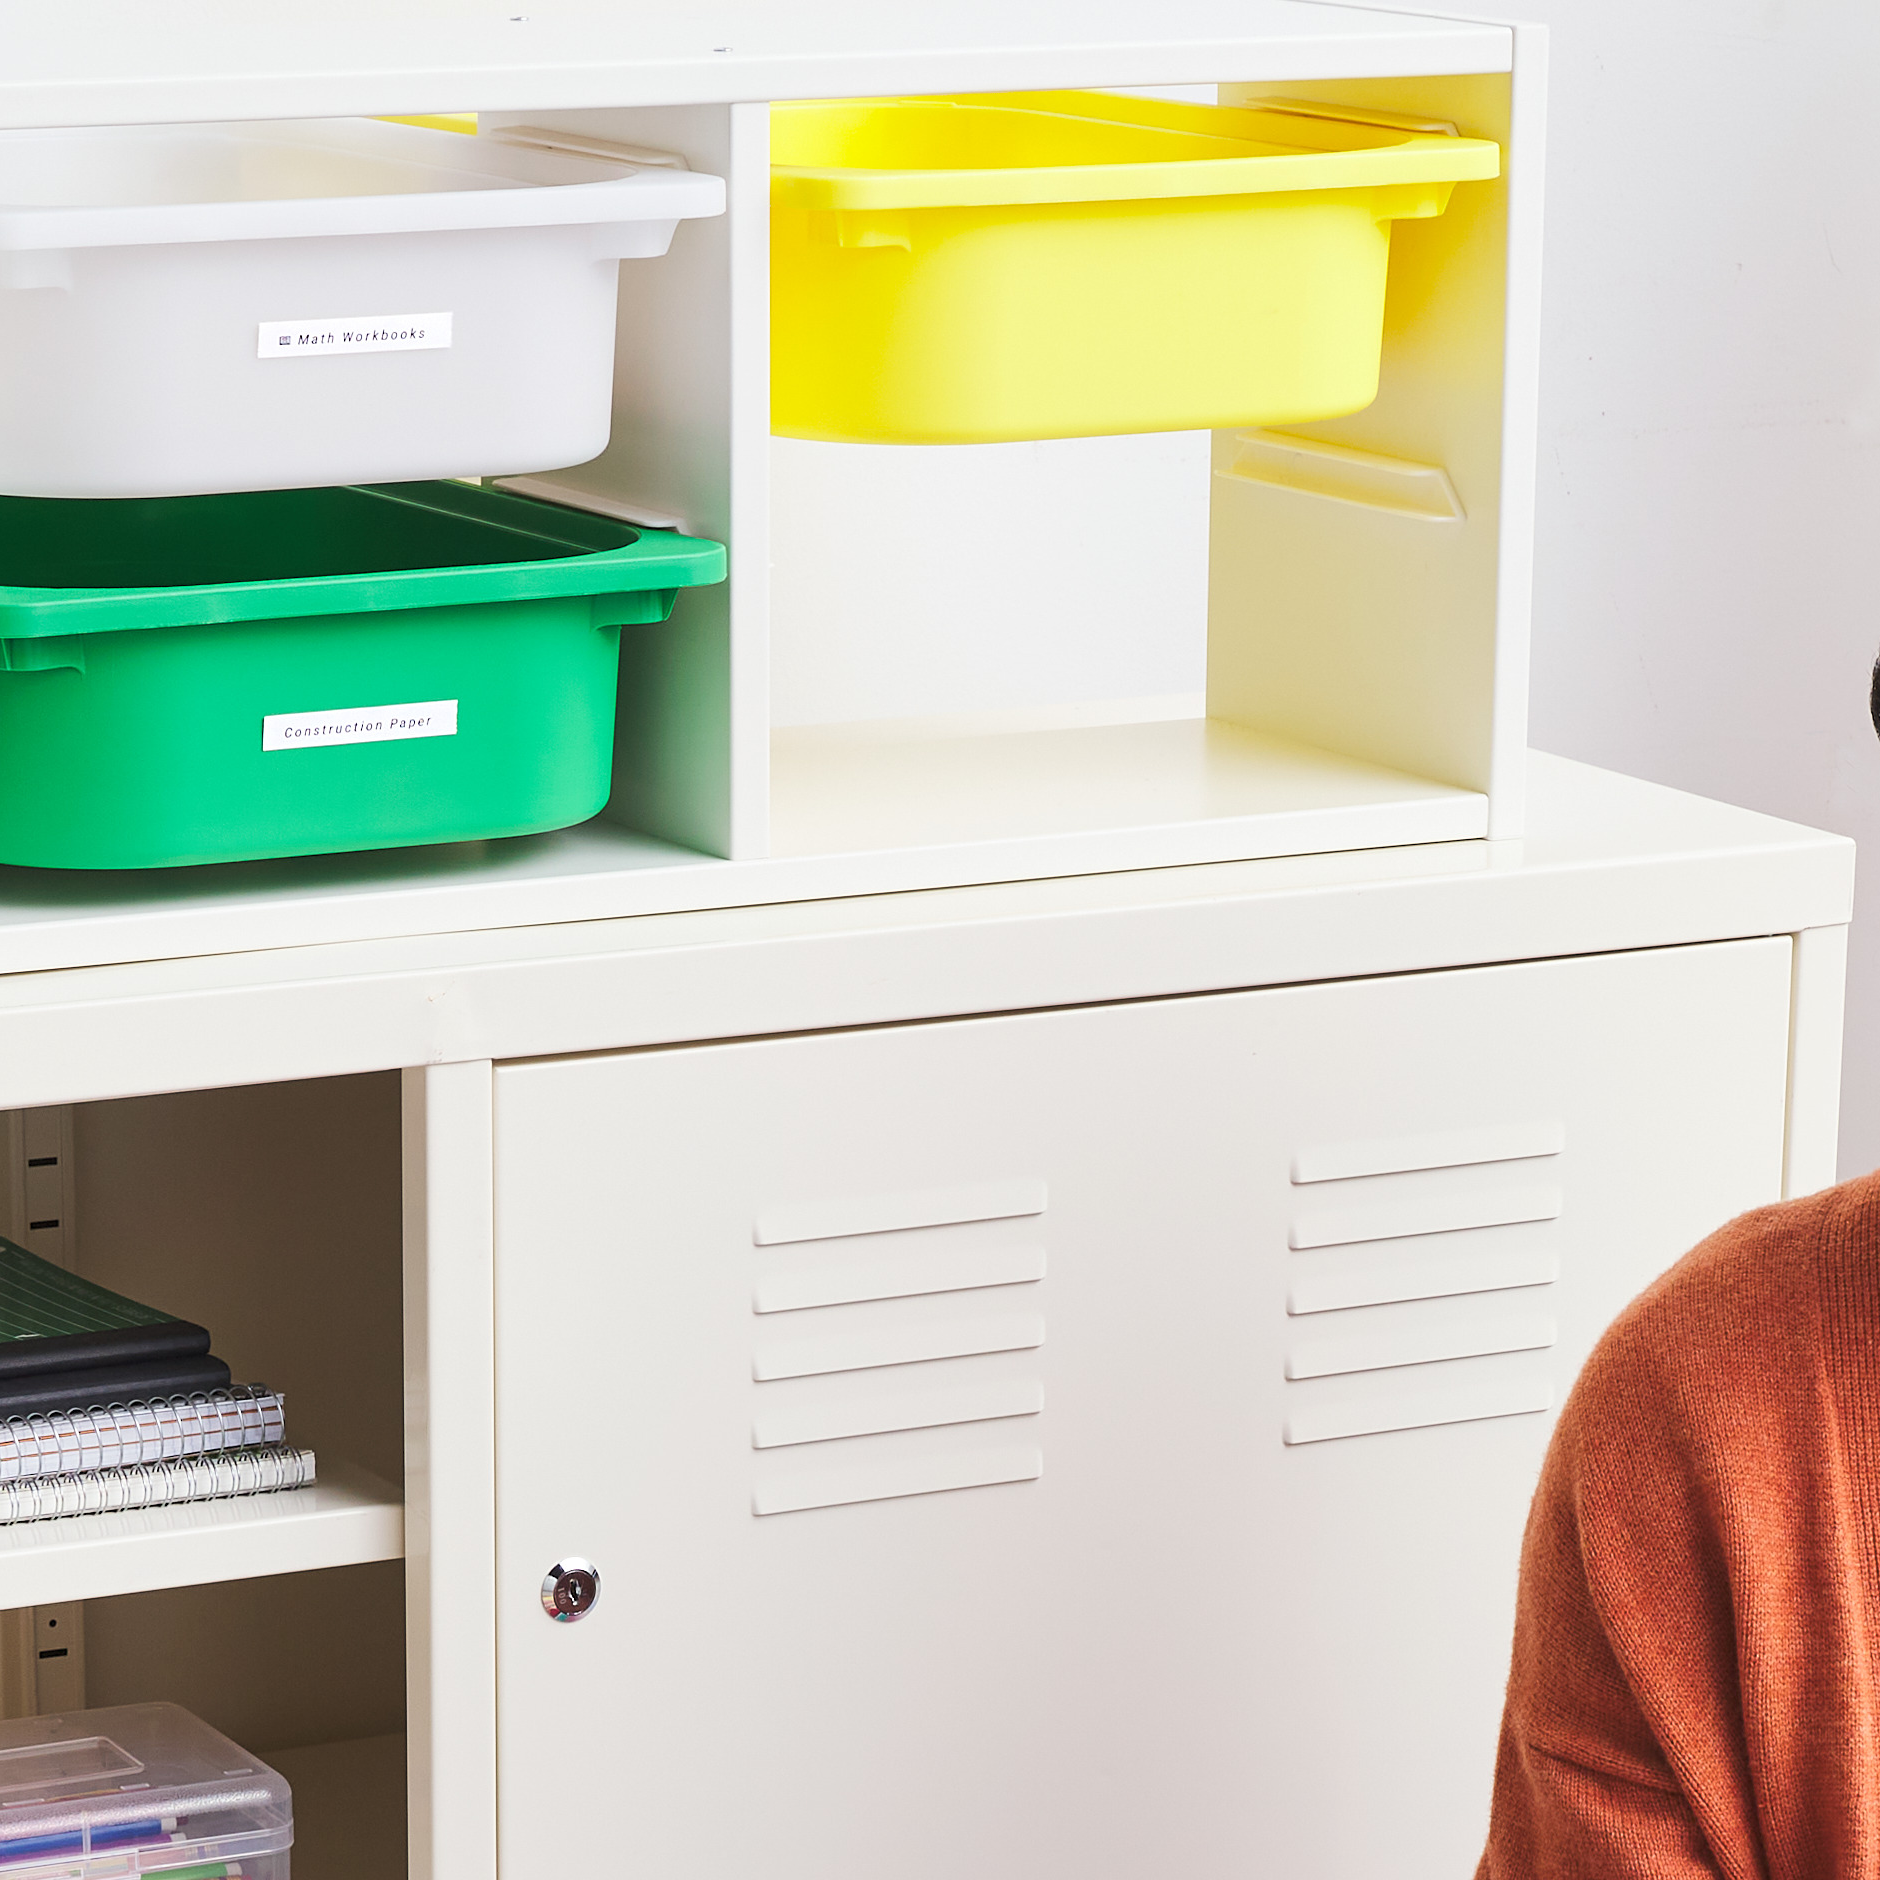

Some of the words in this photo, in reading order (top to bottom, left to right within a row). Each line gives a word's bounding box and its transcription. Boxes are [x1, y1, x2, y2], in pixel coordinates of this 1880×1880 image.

[297, 332, 336, 346] Math
[342, 327, 426, 343] Workbooks
[284, 720, 384, 739] Construction
[389, 716, 432, 730] Paper
